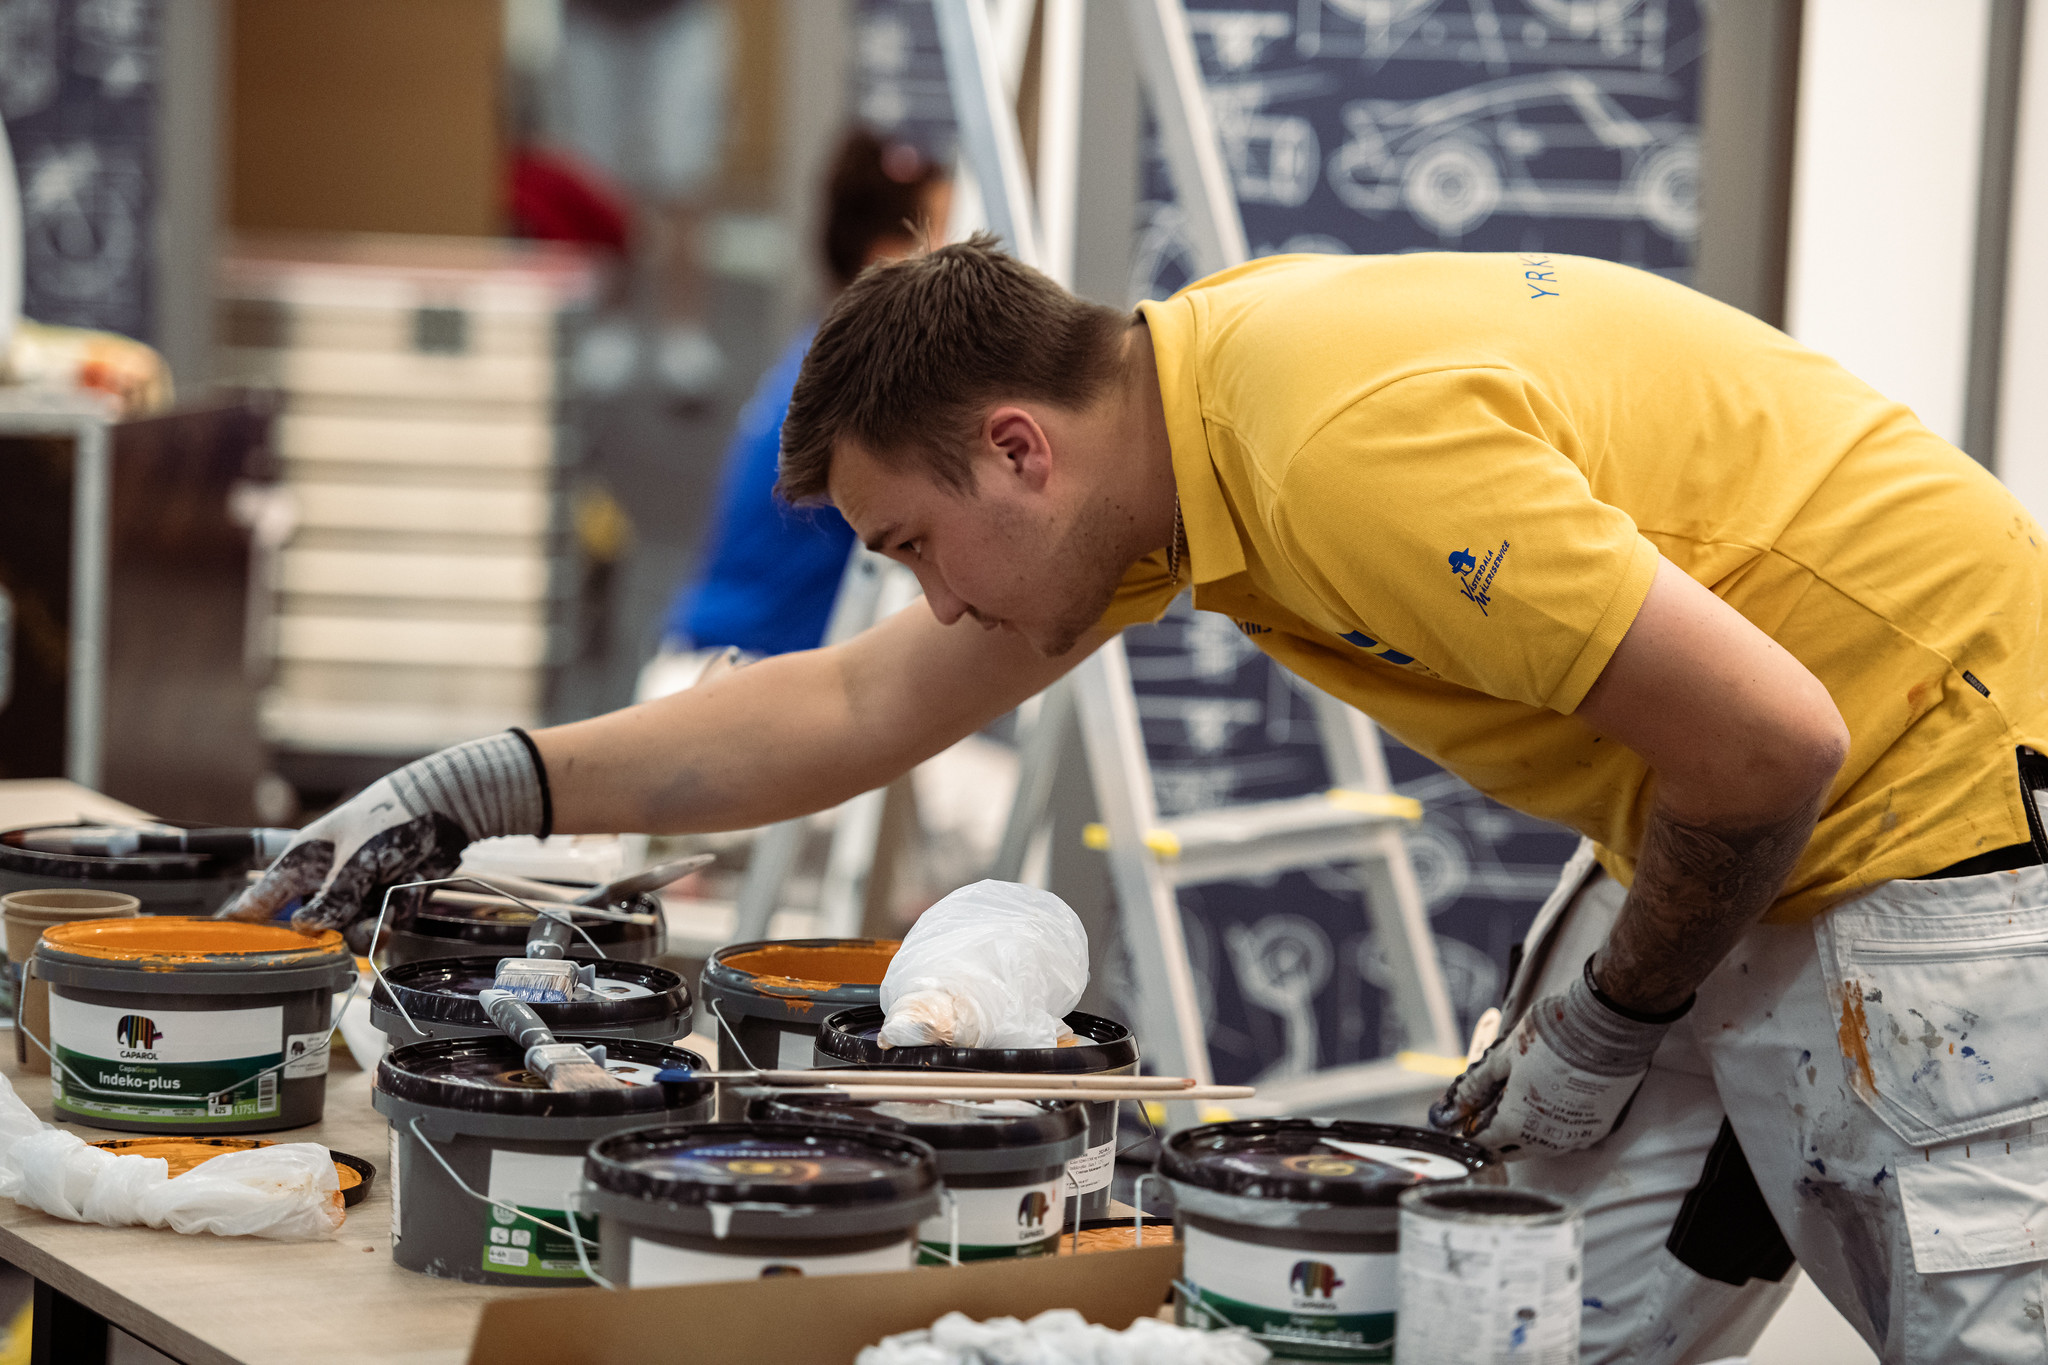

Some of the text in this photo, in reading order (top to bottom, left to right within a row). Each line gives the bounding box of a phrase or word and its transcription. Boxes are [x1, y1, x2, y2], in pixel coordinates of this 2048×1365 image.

[1518, 254, 1560, 299] YRK
[1475, 539, 1510, 617] MÅLERISERVICE
[119, 1050, 159, 1060] CAPAROL
[119, 1064, 158, 1074] CapaGreen
[99, 1071, 181, 1091] Indeko-plus
